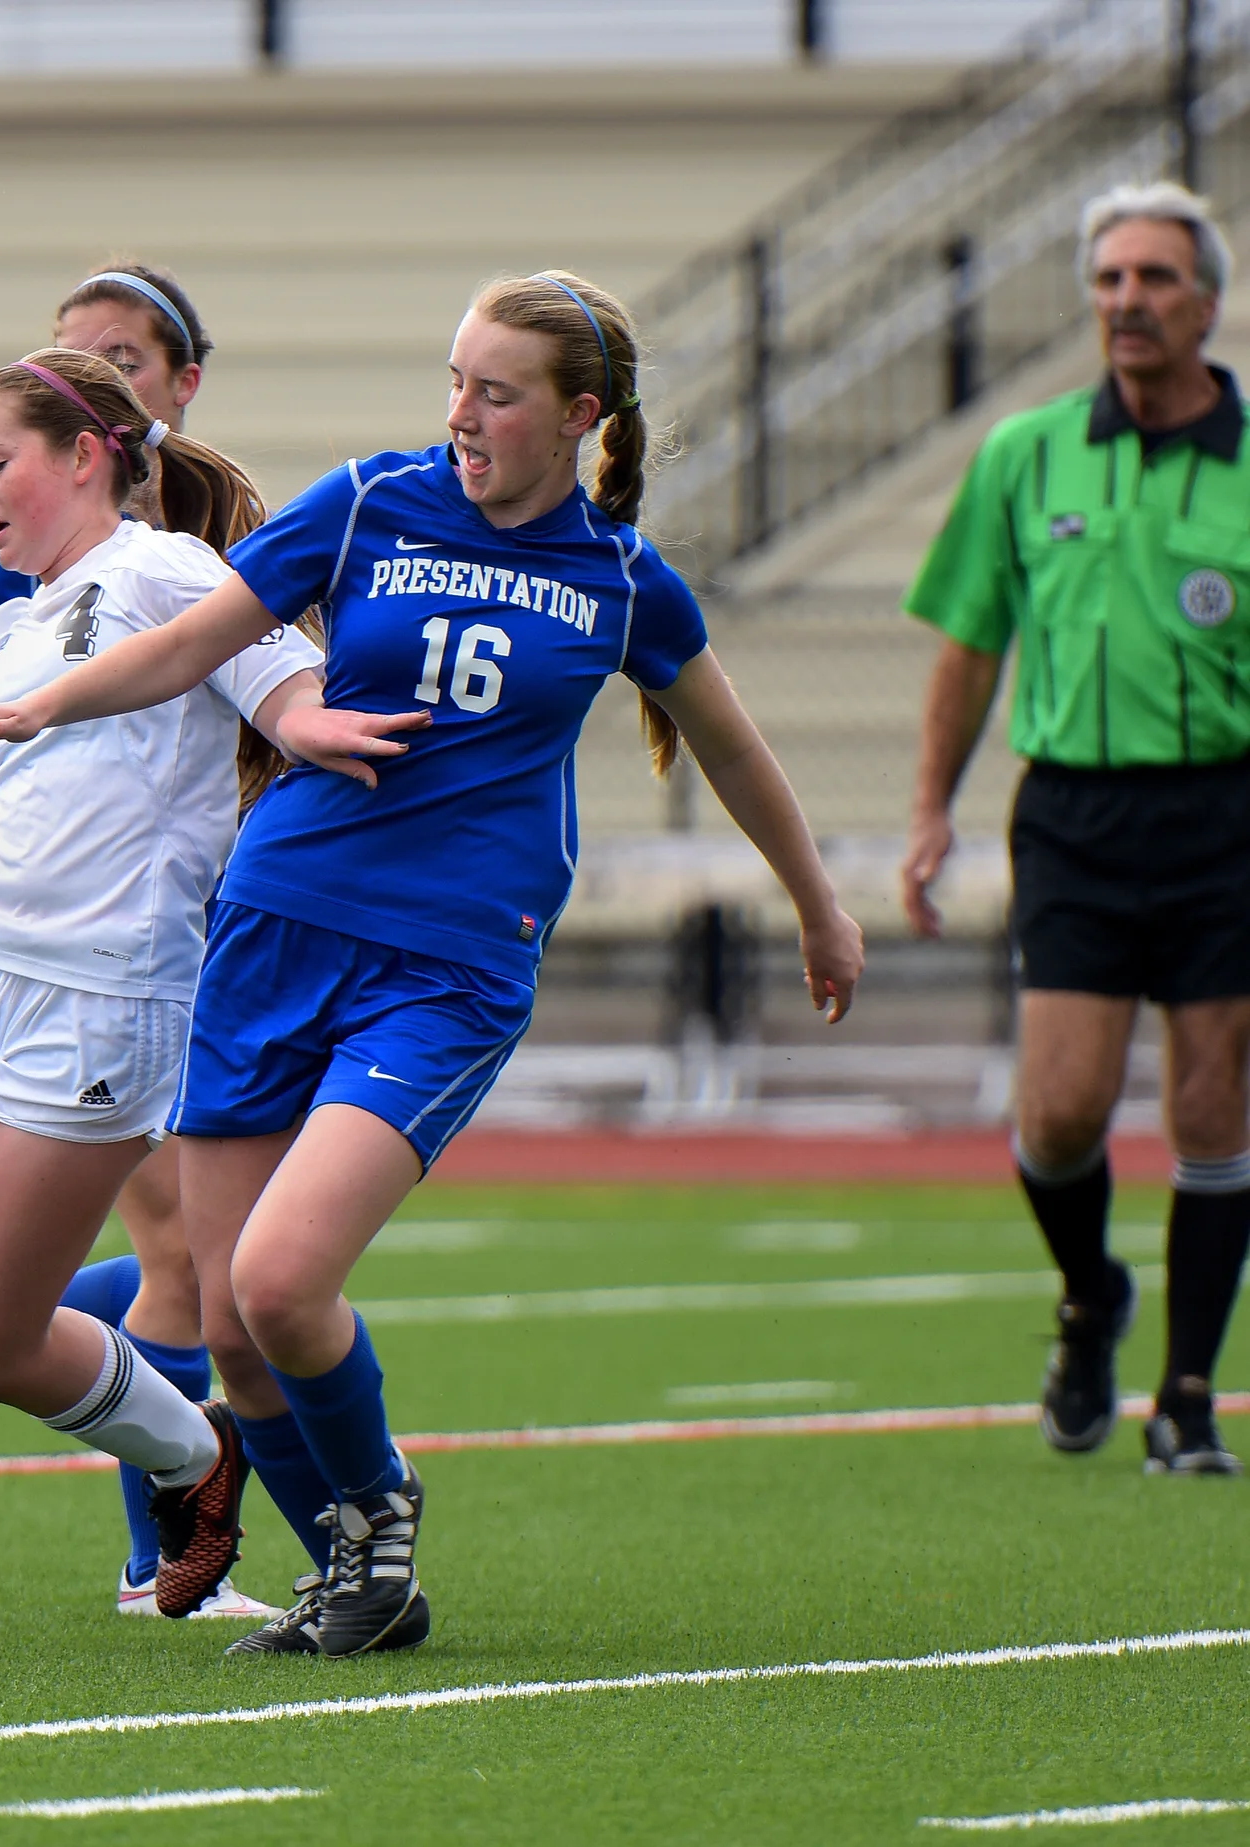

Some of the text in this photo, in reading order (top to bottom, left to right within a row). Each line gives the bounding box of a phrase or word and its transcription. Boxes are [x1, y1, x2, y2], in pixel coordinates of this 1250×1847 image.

[55, 582, 105, 661] 4
[367, 558, 599, 637] PRESENTATION
[414, 617, 512, 714] 16
[79, 1096, 116, 1105] adidas
